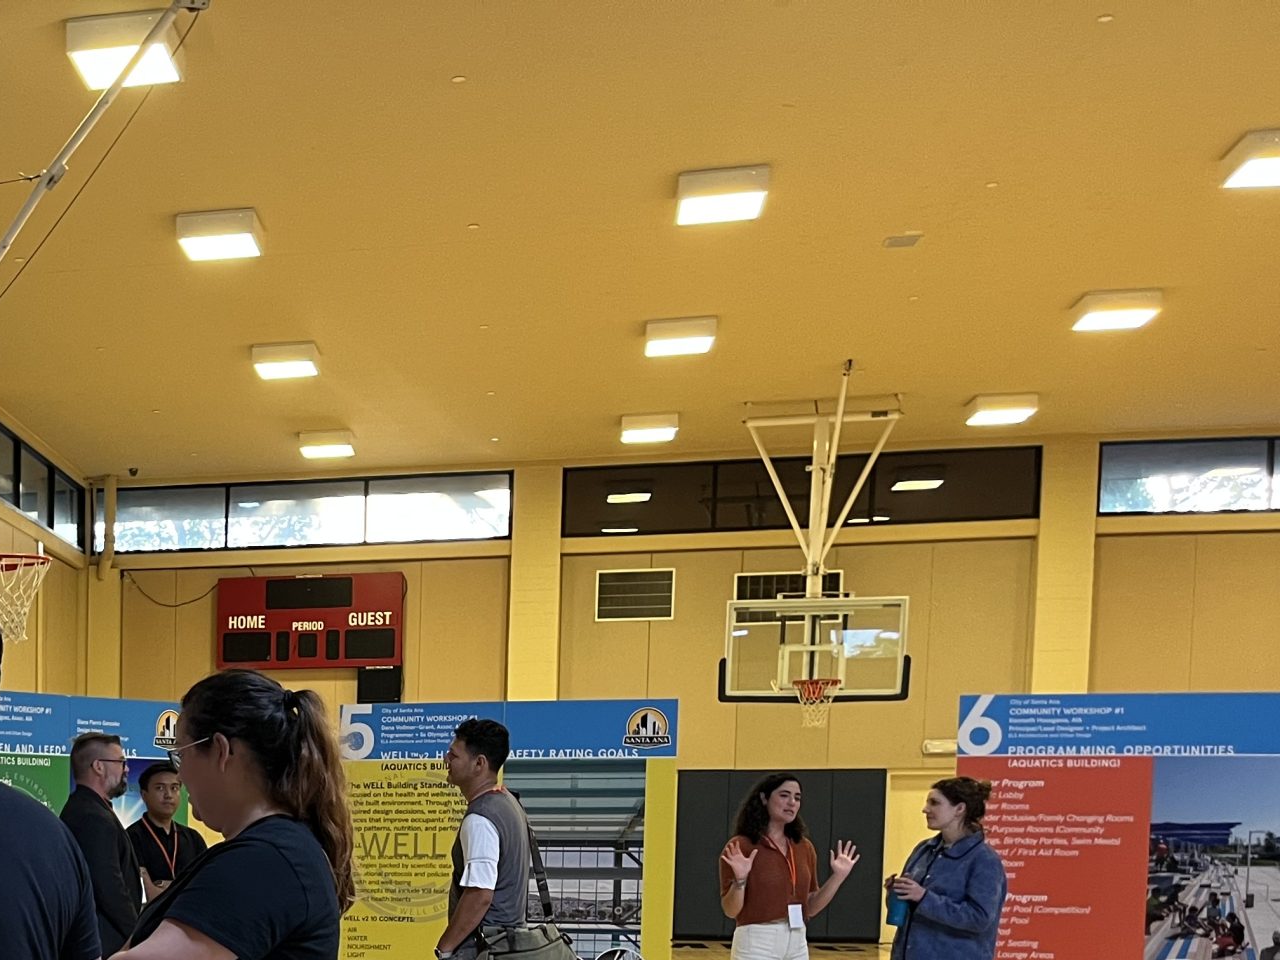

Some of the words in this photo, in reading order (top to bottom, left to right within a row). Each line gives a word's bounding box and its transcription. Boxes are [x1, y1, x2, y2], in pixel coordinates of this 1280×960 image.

[229, 615, 266, 629] HOME
[348, 611, 392, 626] GUEST
[292, 621, 324, 631] PERIOD
[1009, 708, 1061, 716] COMMUNITY
[1063, 707, 1112, 715] WORKSHOP
[381, 715, 424, 723] COMMUNITY
[957, 695, 1002, 756] 6
[339, 704, 374, 759] 5
[15, 744, 34, 754] AND
[509, 749, 544, 758] AFETY
[549, 749, 593, 758] RATING
[598, 748, 639, 757] GOALS
[1123, 745, 1234, 756] OPPORTUNITIES
[17, 757, 51, 766] BUILDING)
[1008, 759, 1064, 768] (AQUATICS
[1067, 759, 1120, 768] BUILDING)
[1002, 779, 1044, 789] Program
[360, 833, 446, 859] WELL
[1030, 951, 1054, 959] Areas
